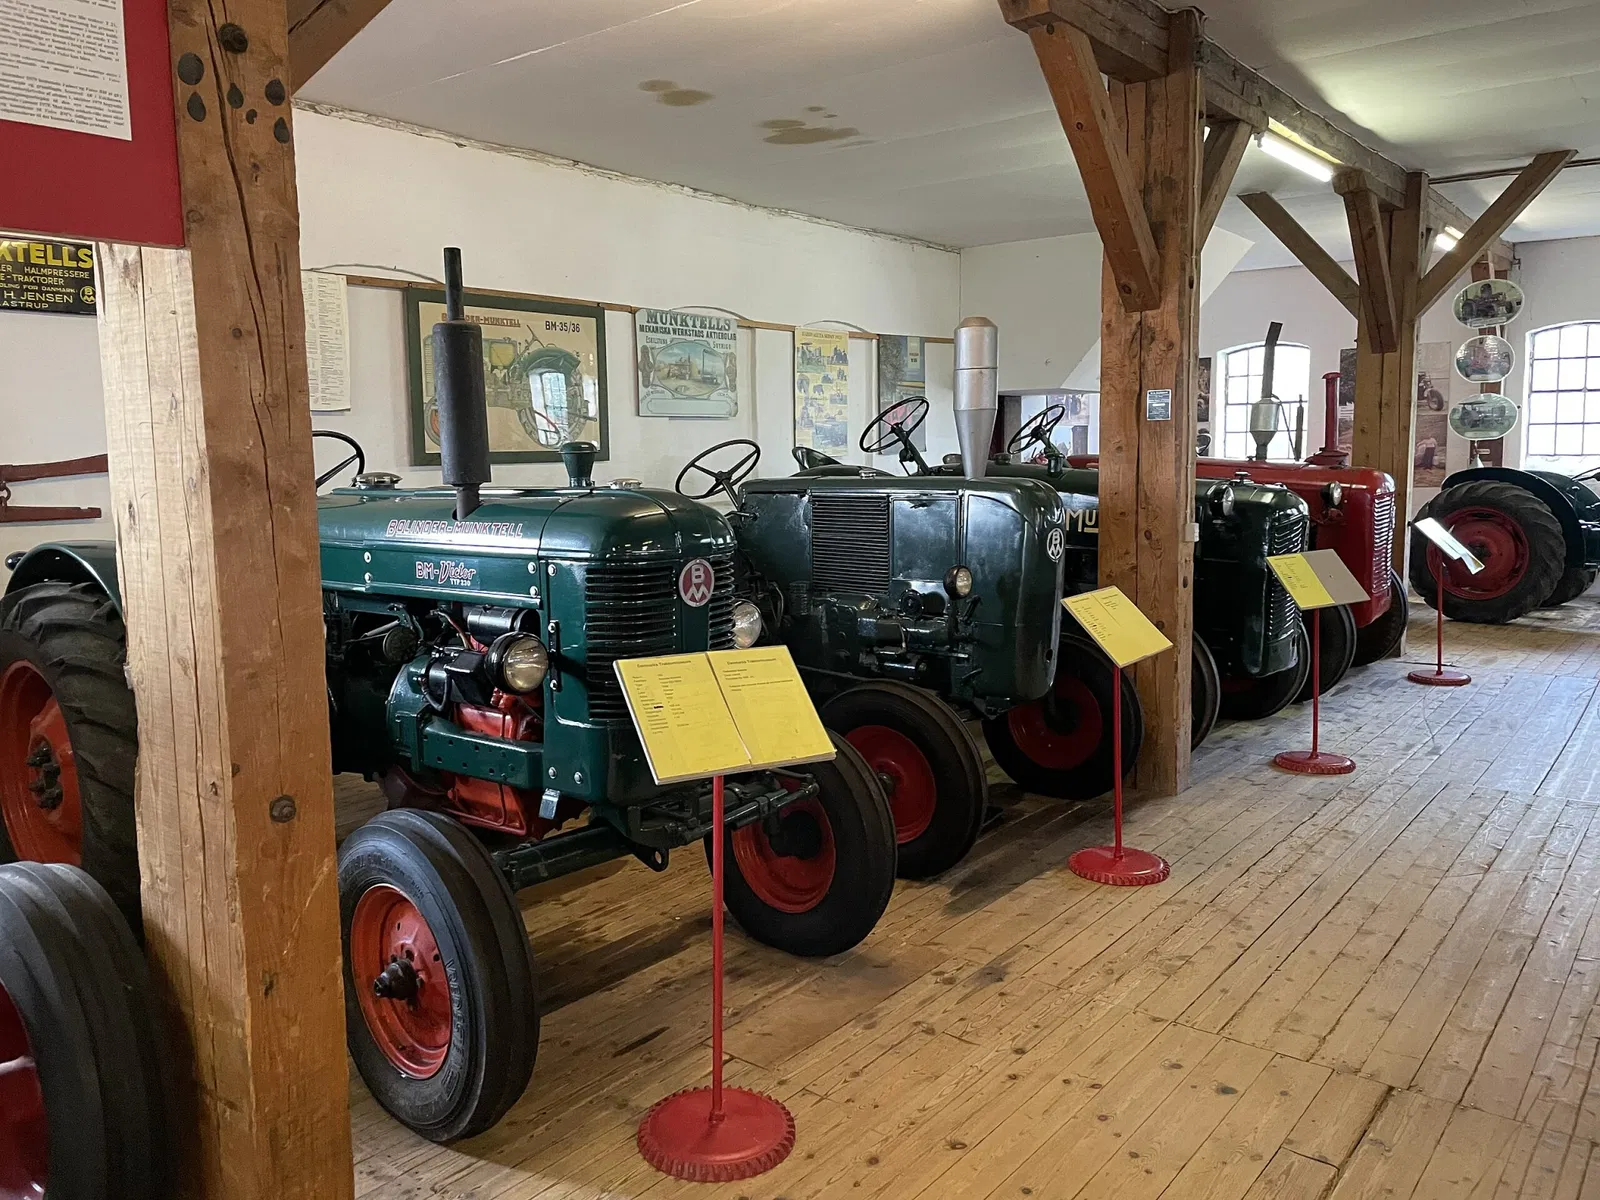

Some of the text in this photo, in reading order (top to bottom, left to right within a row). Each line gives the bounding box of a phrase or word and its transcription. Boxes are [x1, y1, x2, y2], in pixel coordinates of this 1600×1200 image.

[24, 266, 90, 279] HALMPRESSERE
[20, 292, 73, 303] JENSEN
[545, 320, 580, 333] BM-35/36
[646, 310, 731, 331] MUNKTELLS
[639, 324, 671, 335] MEKANISKA
[706, 330, 736, 340] AKTIEBOLAG
[386, 519, 523, 538] BOLINDER-MUNKTELL
[415, 560, 476, 584] BM-Victor
